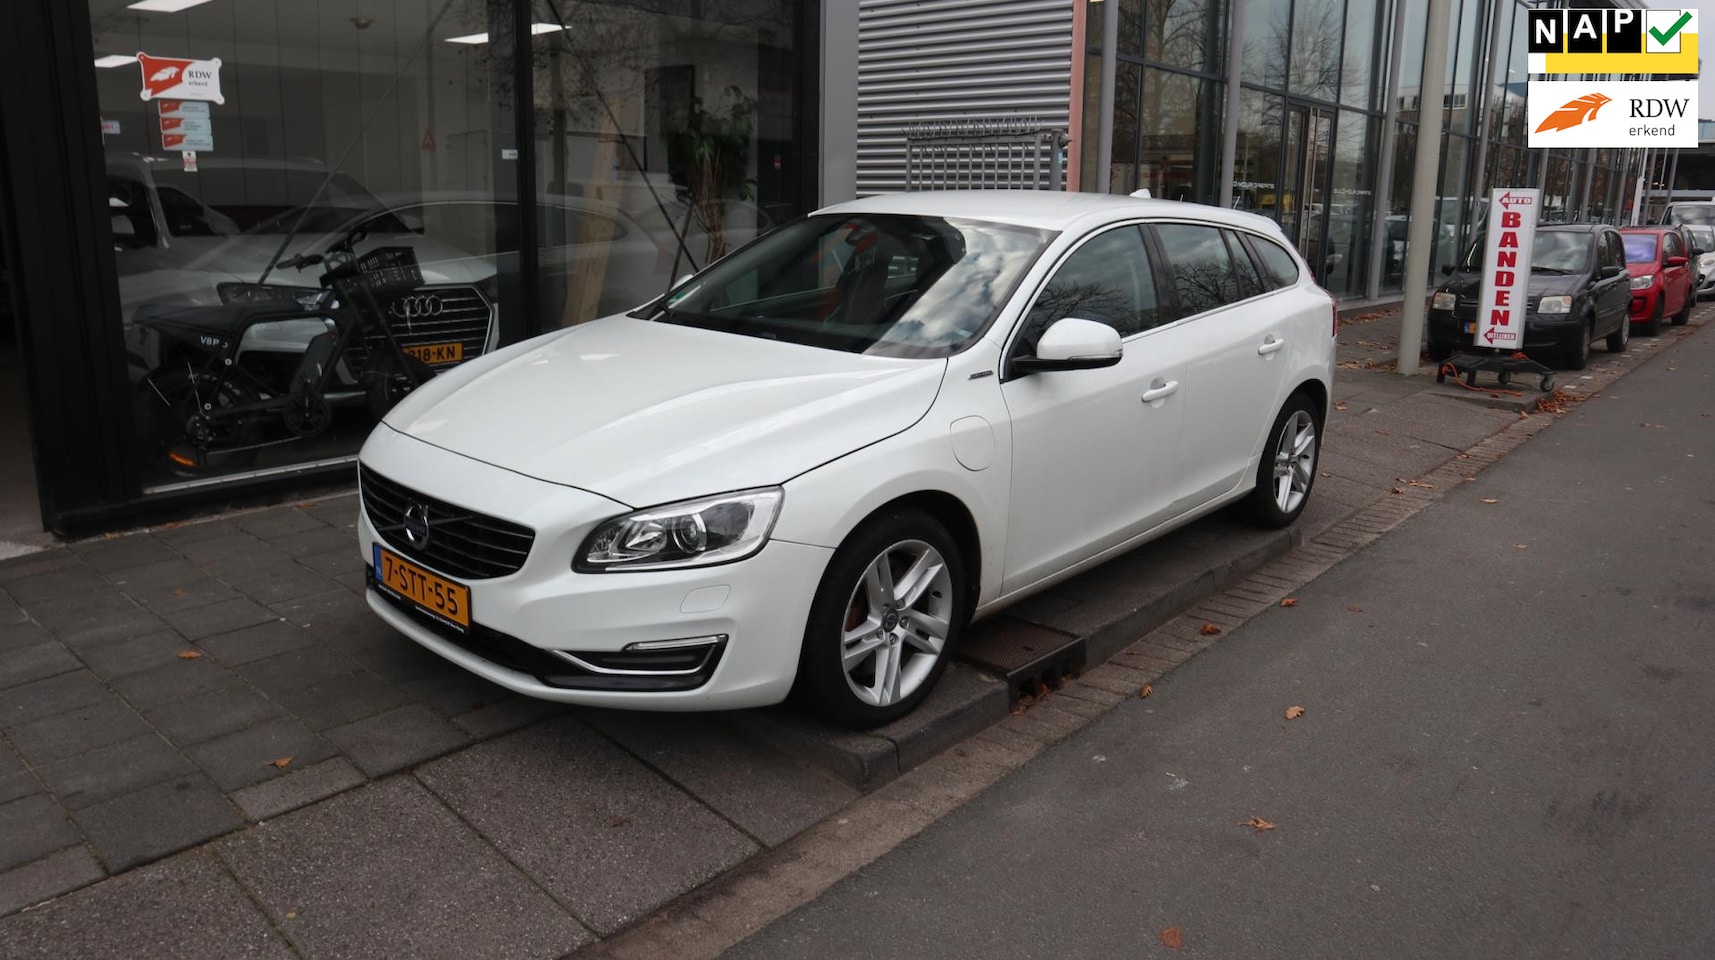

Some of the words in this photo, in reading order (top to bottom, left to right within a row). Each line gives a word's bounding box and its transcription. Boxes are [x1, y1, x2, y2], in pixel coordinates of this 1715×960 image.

[188, 70, 212, 79] RDW
[1490, 212, 1522, 326] BANDEN
[386, 556, 458, 615] 7-STT-55
